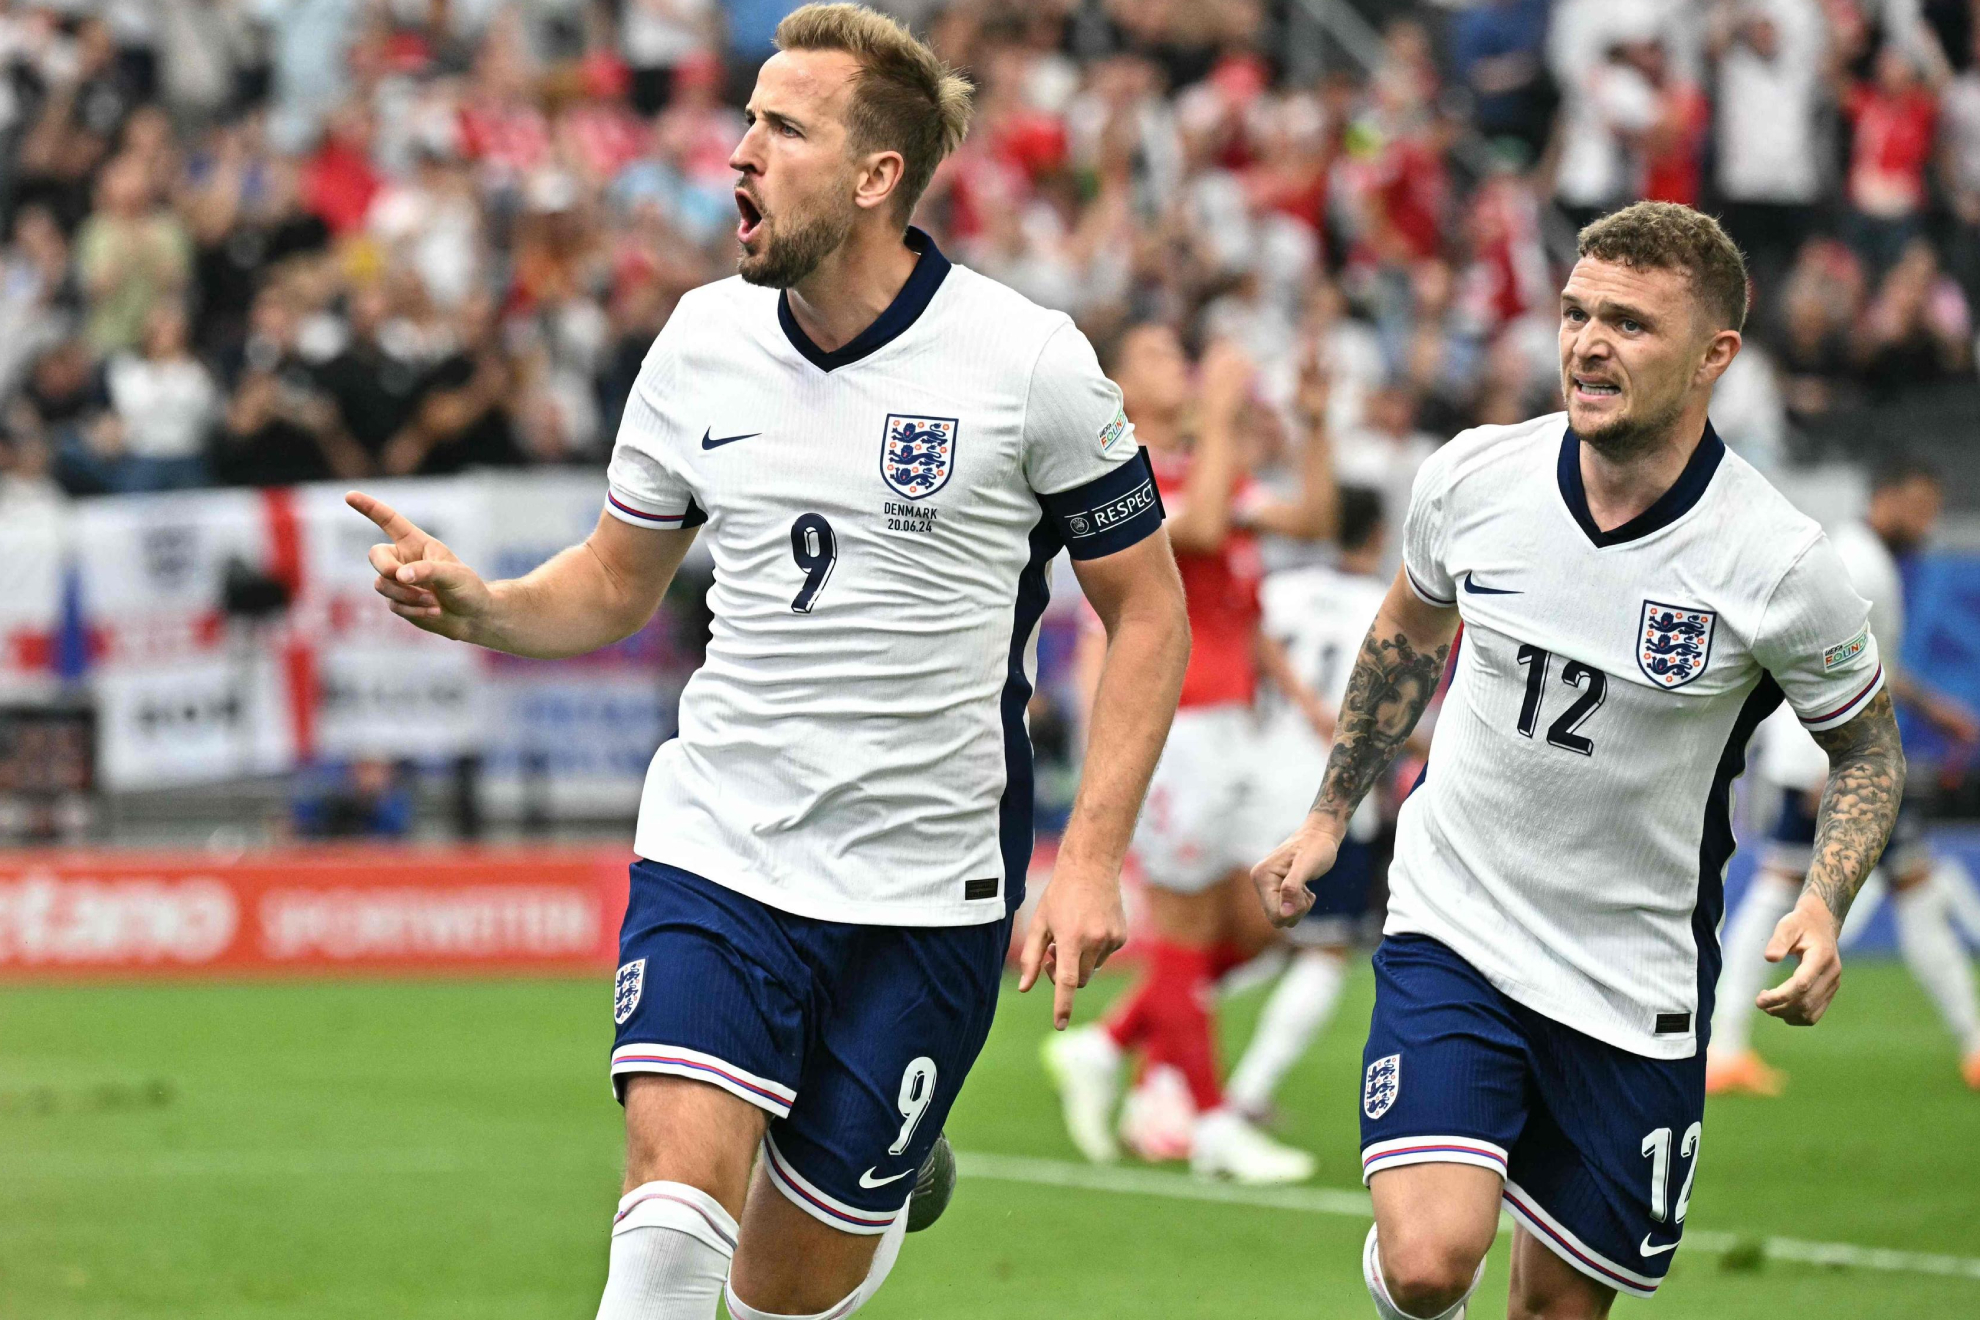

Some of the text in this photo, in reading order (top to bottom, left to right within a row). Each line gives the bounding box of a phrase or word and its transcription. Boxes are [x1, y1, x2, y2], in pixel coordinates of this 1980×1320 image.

[884, 502, 938, 519] DENMARK
[887, 518, 932, 533] 20.06.24
[1094, 483, 1154, 527] RESPECT
[790, 512, 838, 614] 9
[1517, 643, 1608, 757] 12
[888, 1056, 938, 1156] 9
[1641, 1121, 1702, 1224] 12
